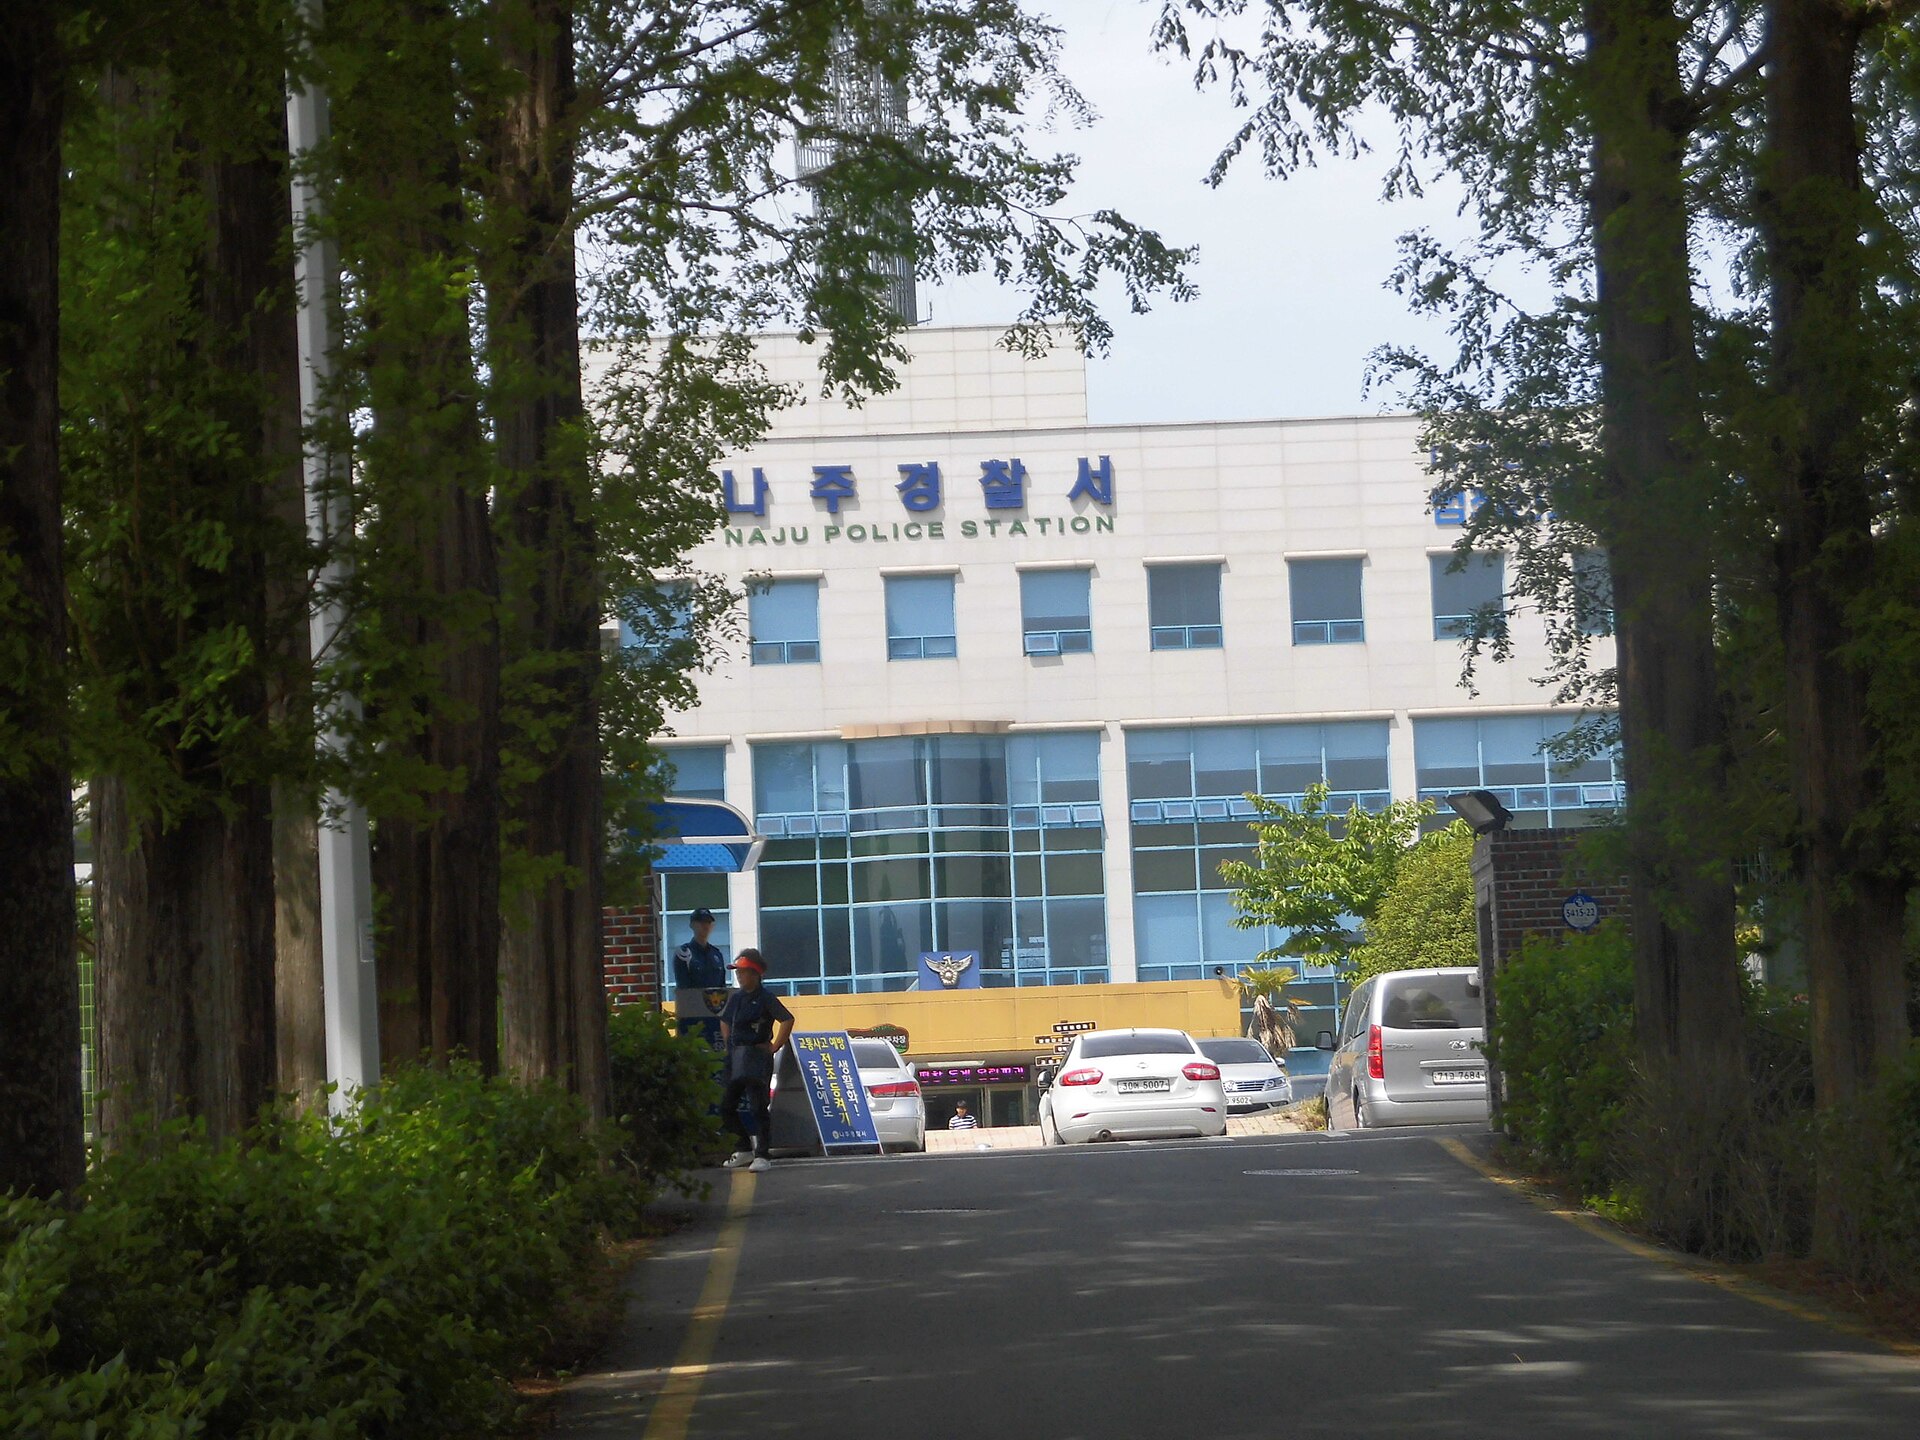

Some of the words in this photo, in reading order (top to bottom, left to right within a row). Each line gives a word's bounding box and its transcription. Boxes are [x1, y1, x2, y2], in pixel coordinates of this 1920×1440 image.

[721, 455, 1115, 516] 나주경찰서
[724, 526, 809, 546] NAJU
[824, 521, 945, 543] POLICE
[960, 515, 1115, 537] STATION
[1566, 908, 1595, 918] 5415-22
[798, 1037, 829, 1051] 교통사고
[829, 1036, 846, 1050] 예방
[1143, 1080, 1165, 1089] 5007
[1458, 1071, 1480, 1080] 7684
[808, 1060, 834, 1117] 주간에도
[838, 1060, 860, 1117] 생활화!
